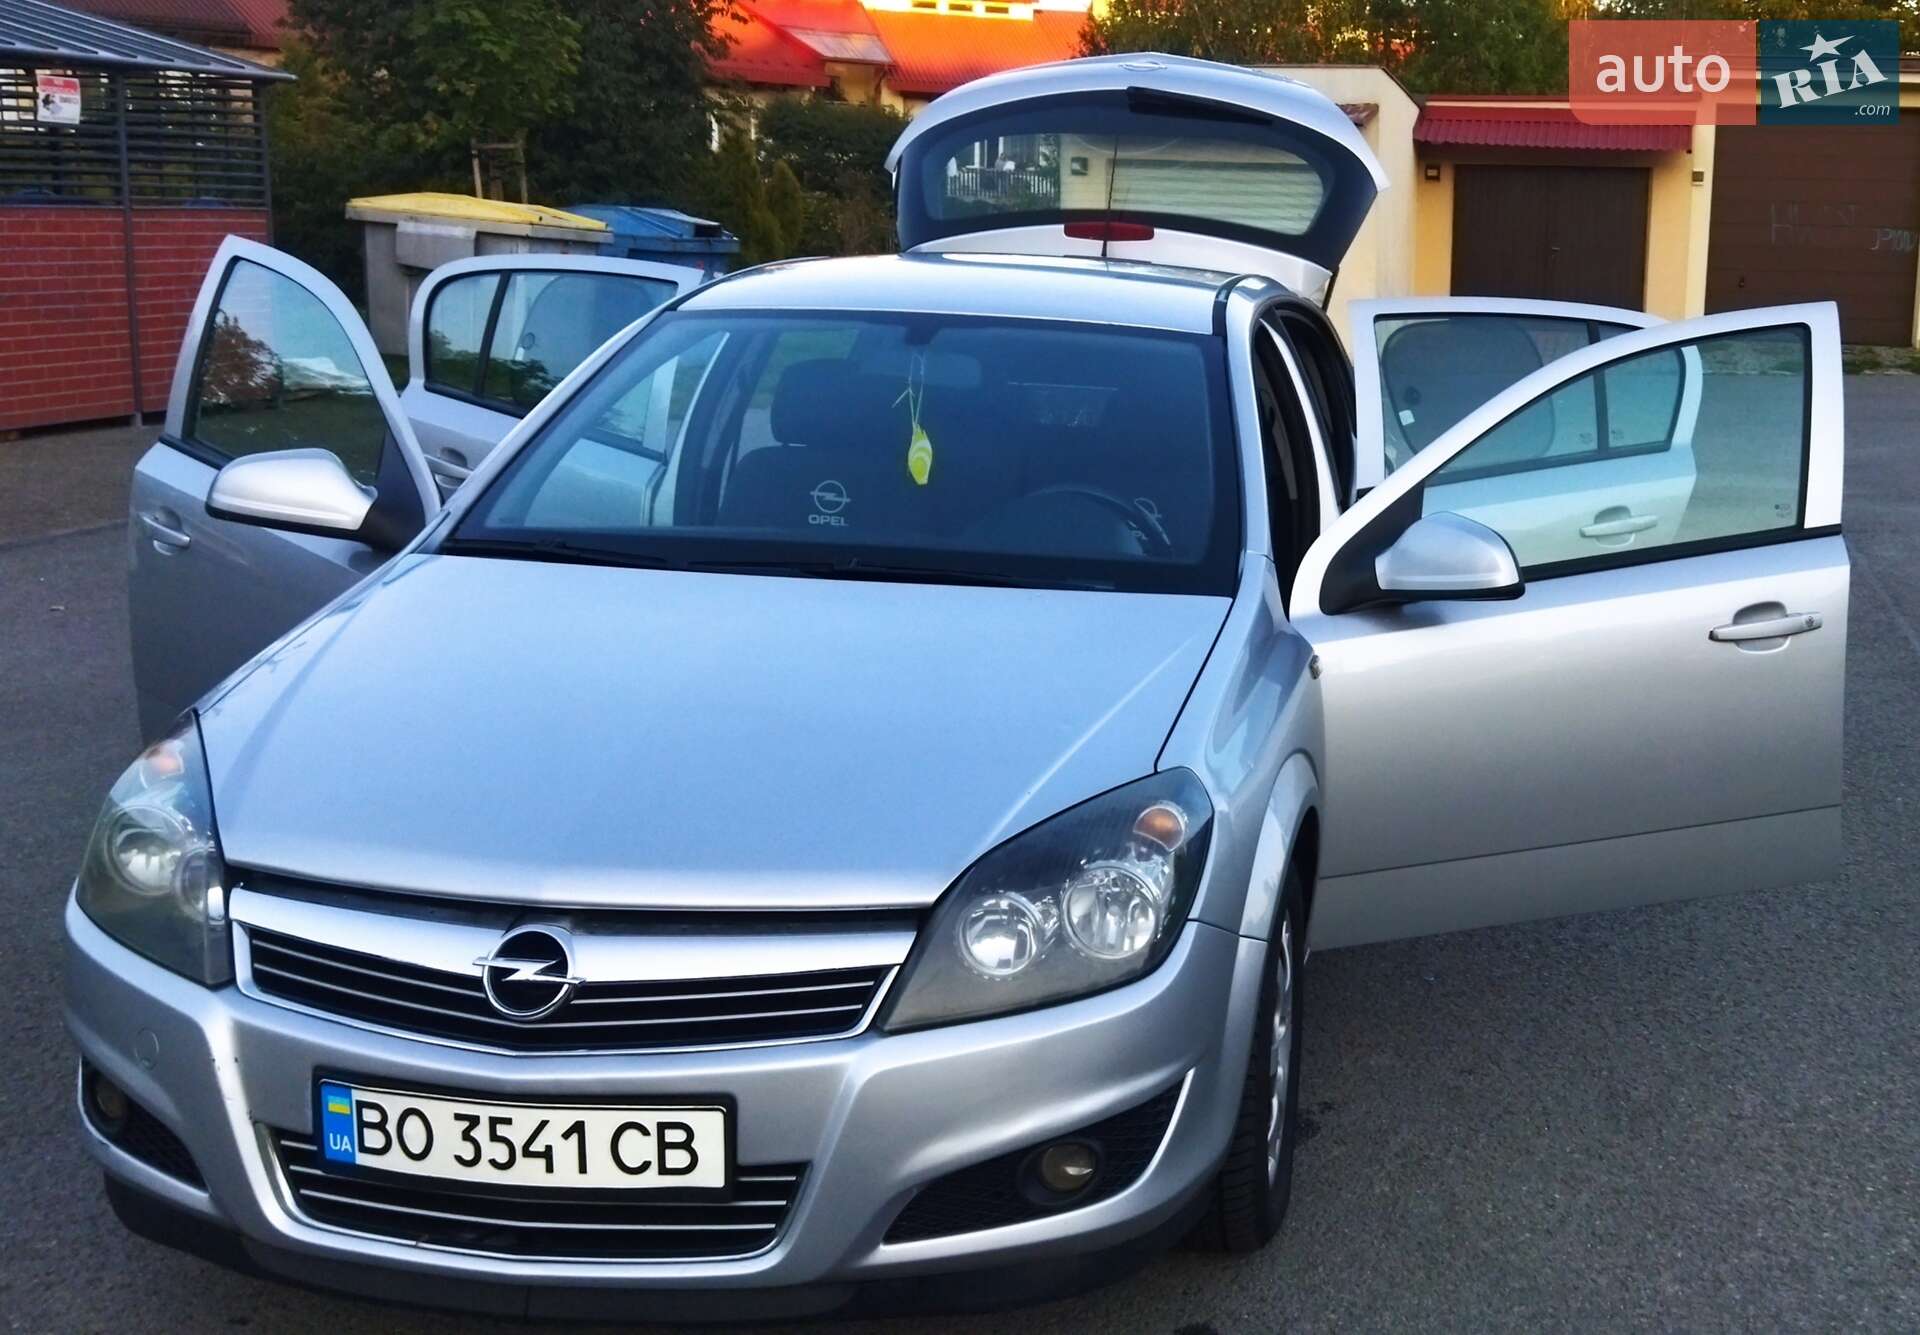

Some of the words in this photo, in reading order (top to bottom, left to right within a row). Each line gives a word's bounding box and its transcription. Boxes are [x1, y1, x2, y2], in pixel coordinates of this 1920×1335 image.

[808, 514, 849, 527] OPEL
[329, 1133, 352, 1152] UA
[355, 1099, 434, 1162] BO
[453, 1112, 588, 1175] 3541
[610, 1120, 699, 1176] CB
